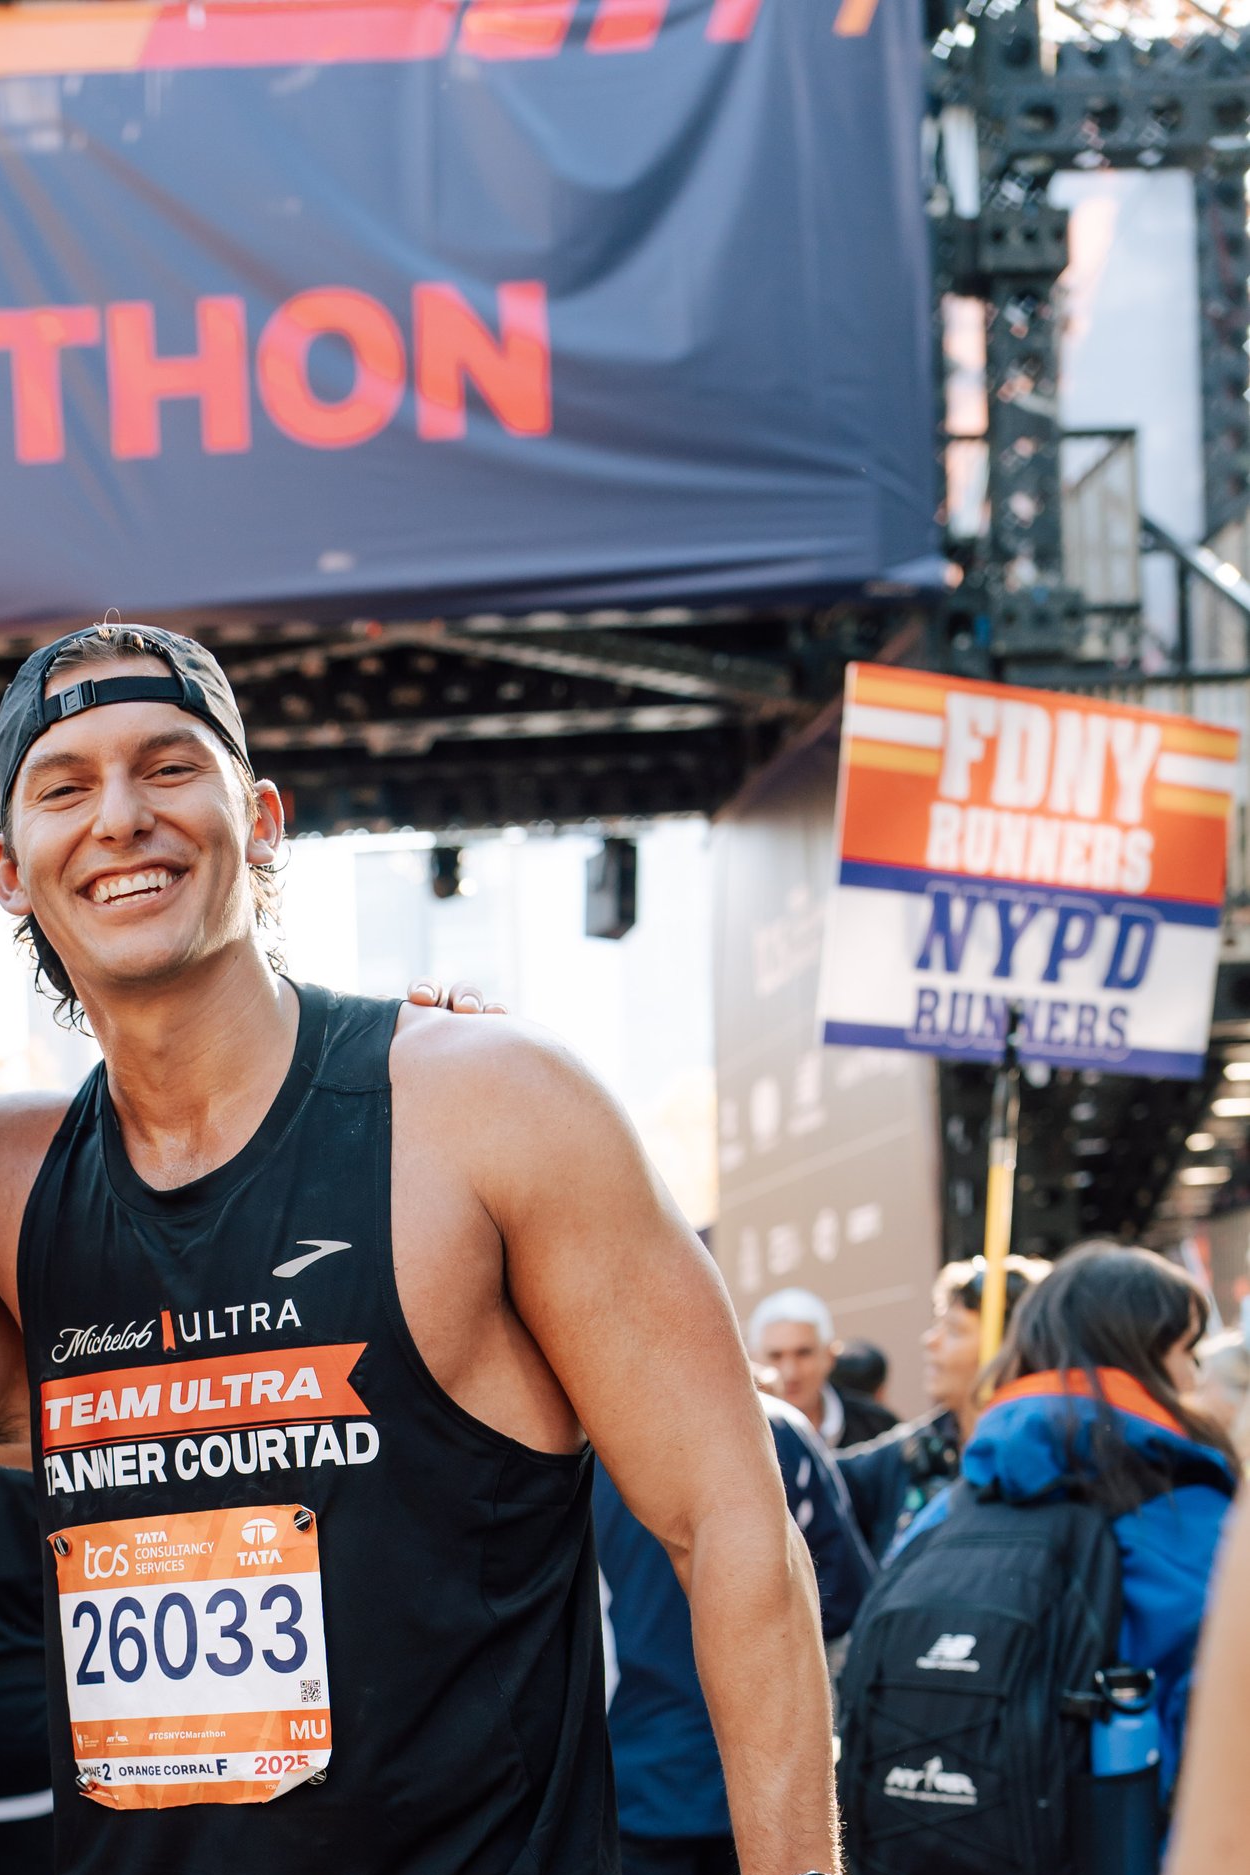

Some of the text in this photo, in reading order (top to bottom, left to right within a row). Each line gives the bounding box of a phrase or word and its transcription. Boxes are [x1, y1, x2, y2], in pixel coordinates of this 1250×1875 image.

[938, 691, 1161, 824] FDNY
[925, 801, 1154, 895] RUNNERS
[913, 884, 1162, 991] NYPD
[910, 986, 1131, 1053] RUNNERS
[51, 1299, 302, 1364] Michelob ULTRA
[45, 1366, 323, 1431] TEAM ULTRA
[43, 1421, 380, 1496] TANNER COURTAD
[134, 1531, 168, 1544] TATA
[134, 1541, 215, 1562] CONSULTANCY
[83, 1539, 130, 1579] tcs
[134, 1558, 185, 1575] SERVICES
[237, 1551, 284, 1566] TATA
[71, 1583, 309, 1687] 26033
[148, 1729, 226, 1741] #TCSNYCMarathon
[290, 1719, 327, 1740] MU
[102, 1763, 112, 1781] 2
[118, 1765, 161, 1777] ORANGE
[163, 1763, 214, 1776] CORRAL
[215, 1758, 228, 1776] F
[254, 1755, 309, 1775] 2025
